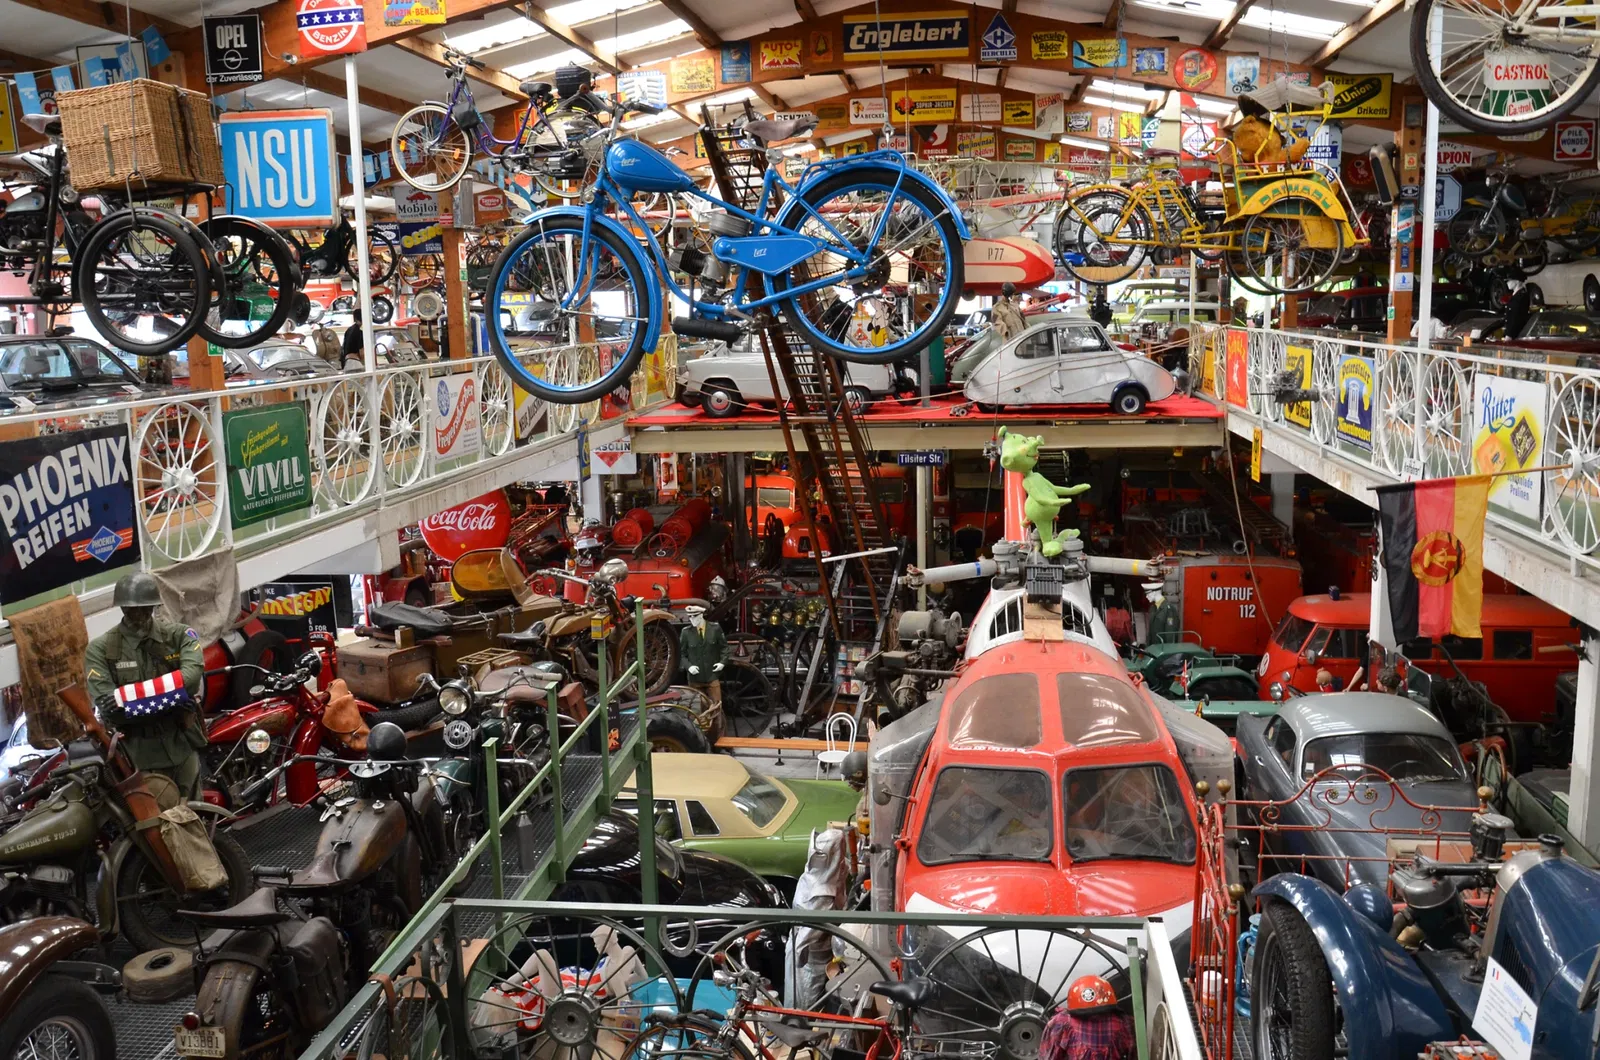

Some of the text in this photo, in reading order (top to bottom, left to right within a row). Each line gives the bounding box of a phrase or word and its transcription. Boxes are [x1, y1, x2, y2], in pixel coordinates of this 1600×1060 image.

[216, 24, 247, 49] OPEL
[312, 27, 348, 43] BENZIN
[849, 20, 962, 50] Englebert
[763, 42, 799, 54] AUTOL
[219, 74, 262, 83] Zuverlässige
[1494, 64, 1549, 81] CASTROL
[1341, 82, 1373, 103] Union
[1357, 105, 1388, 115] Briketts
[1508, 98, 1533, 115] Castrol
[1560, 137, 1589, 146] WONDER
[235, 127, 316, 209] NSU
[398, 202, 438, 215] Mobiloi
[988, 248, 1005, 261] P 77
[1481, 386, 1517, 434] Ritter
[596, 443, 631, 451] ASOLIN
[900, 454, 942, 463] Tilsiter Str.
[238, 456, 306, 500] VIVIL
[1507, 475, 1533, 490] Schokolade
[0, 436, 129, 538] PHOENIX
[1510, 484, 1530, 501] Pralinen
[274, 488, 304, 502] PFEFFERMINZ
[12, 498, 92, 570] REIFEN
[91, 535, 117, 549] PHOENIX
[1206, 586, 1254, 601] NOTRUF
[1239, 603, 1256, 618] 112
